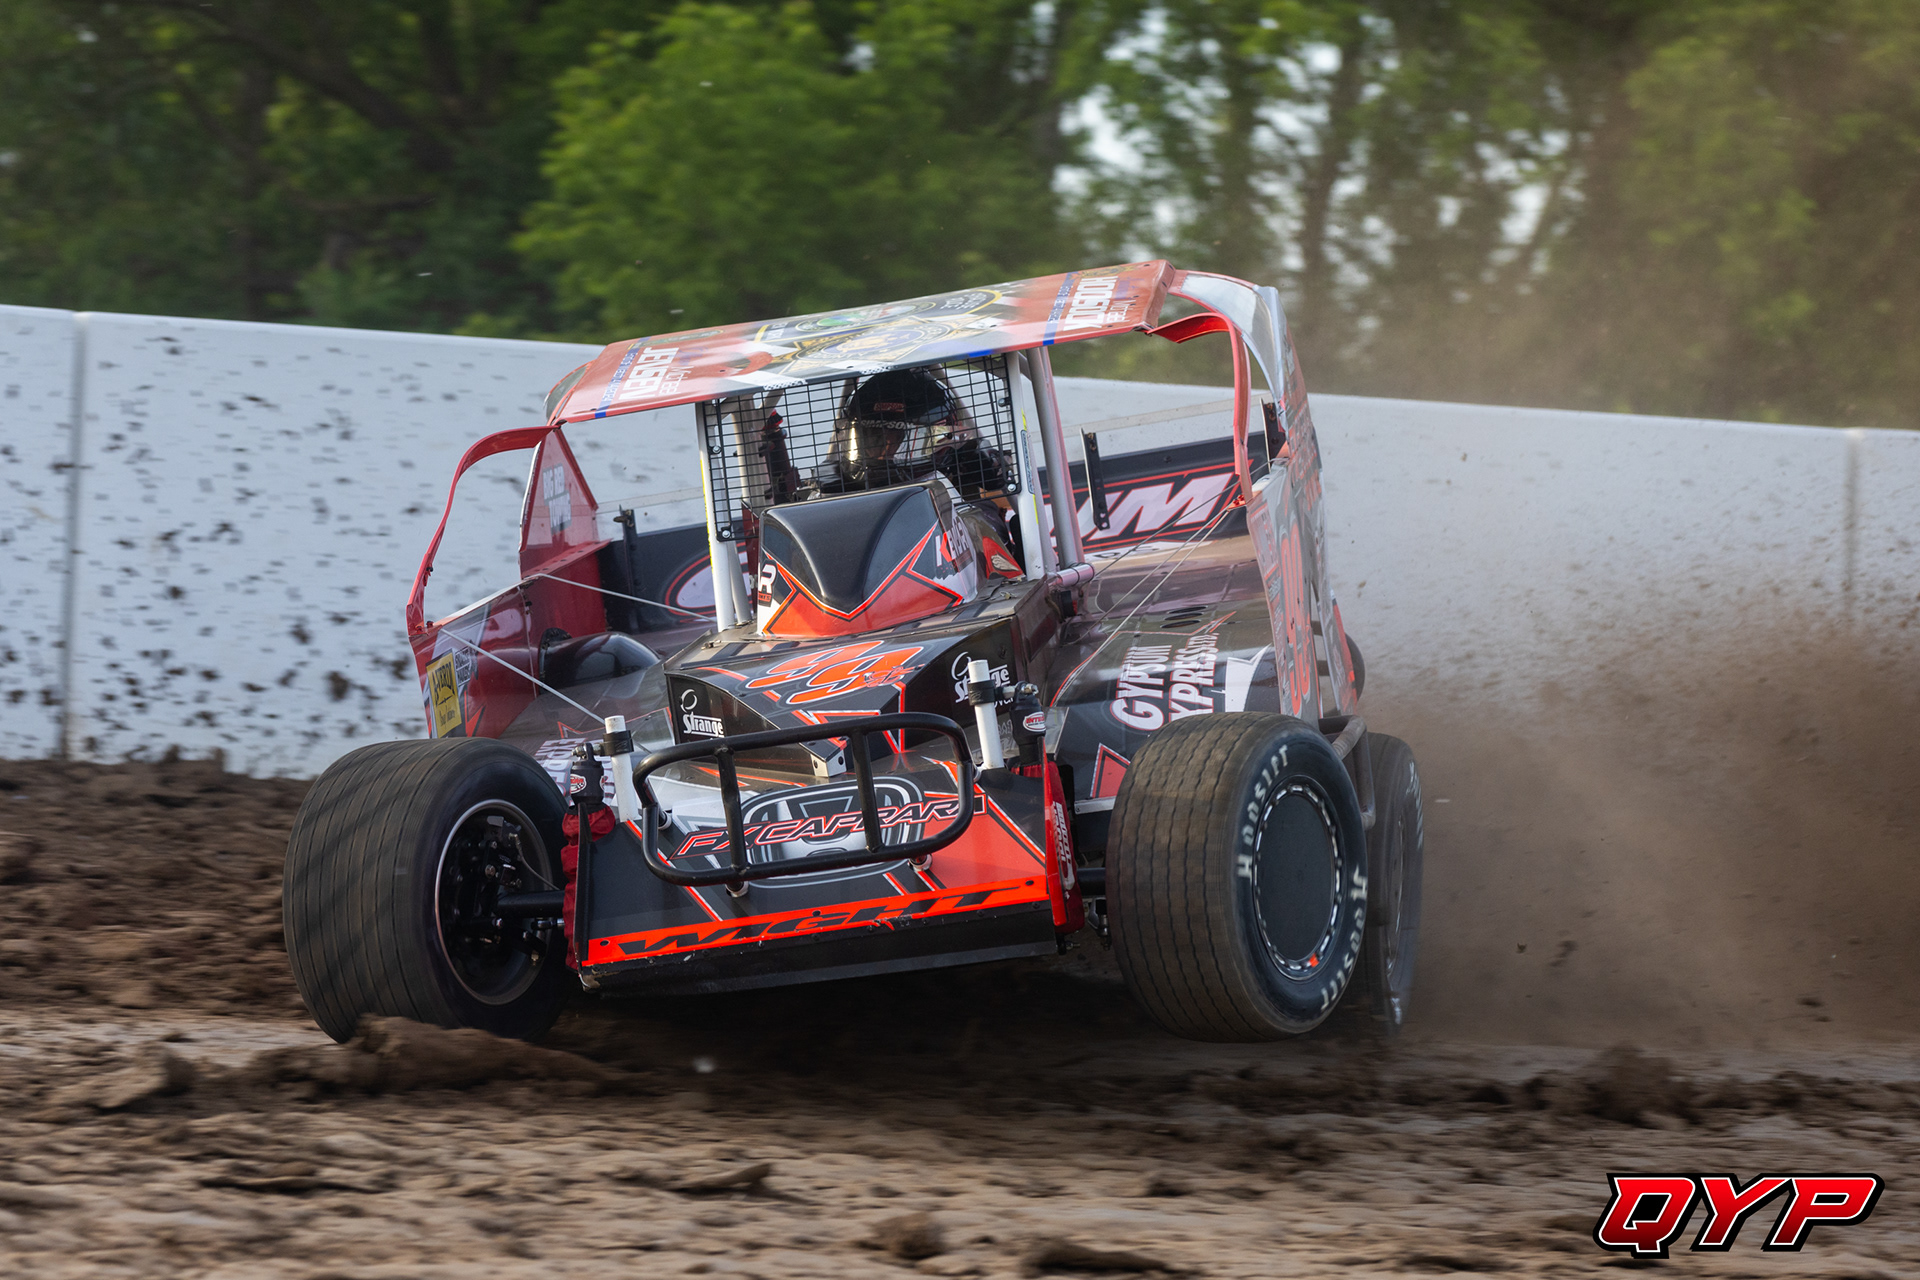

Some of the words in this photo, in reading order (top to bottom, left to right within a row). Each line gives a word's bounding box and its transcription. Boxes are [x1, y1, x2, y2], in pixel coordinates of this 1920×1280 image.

[618, 347, 679, 400] JENSEN
[954, 664, 1010, 703] Stge
[1110, 645, 1172, 731] GYPSUM
[1169, 648, 1219, 723] XPRESS
[683, 711, 724, 738] Strange
[617, 885, 1022, 955] WIGHT
